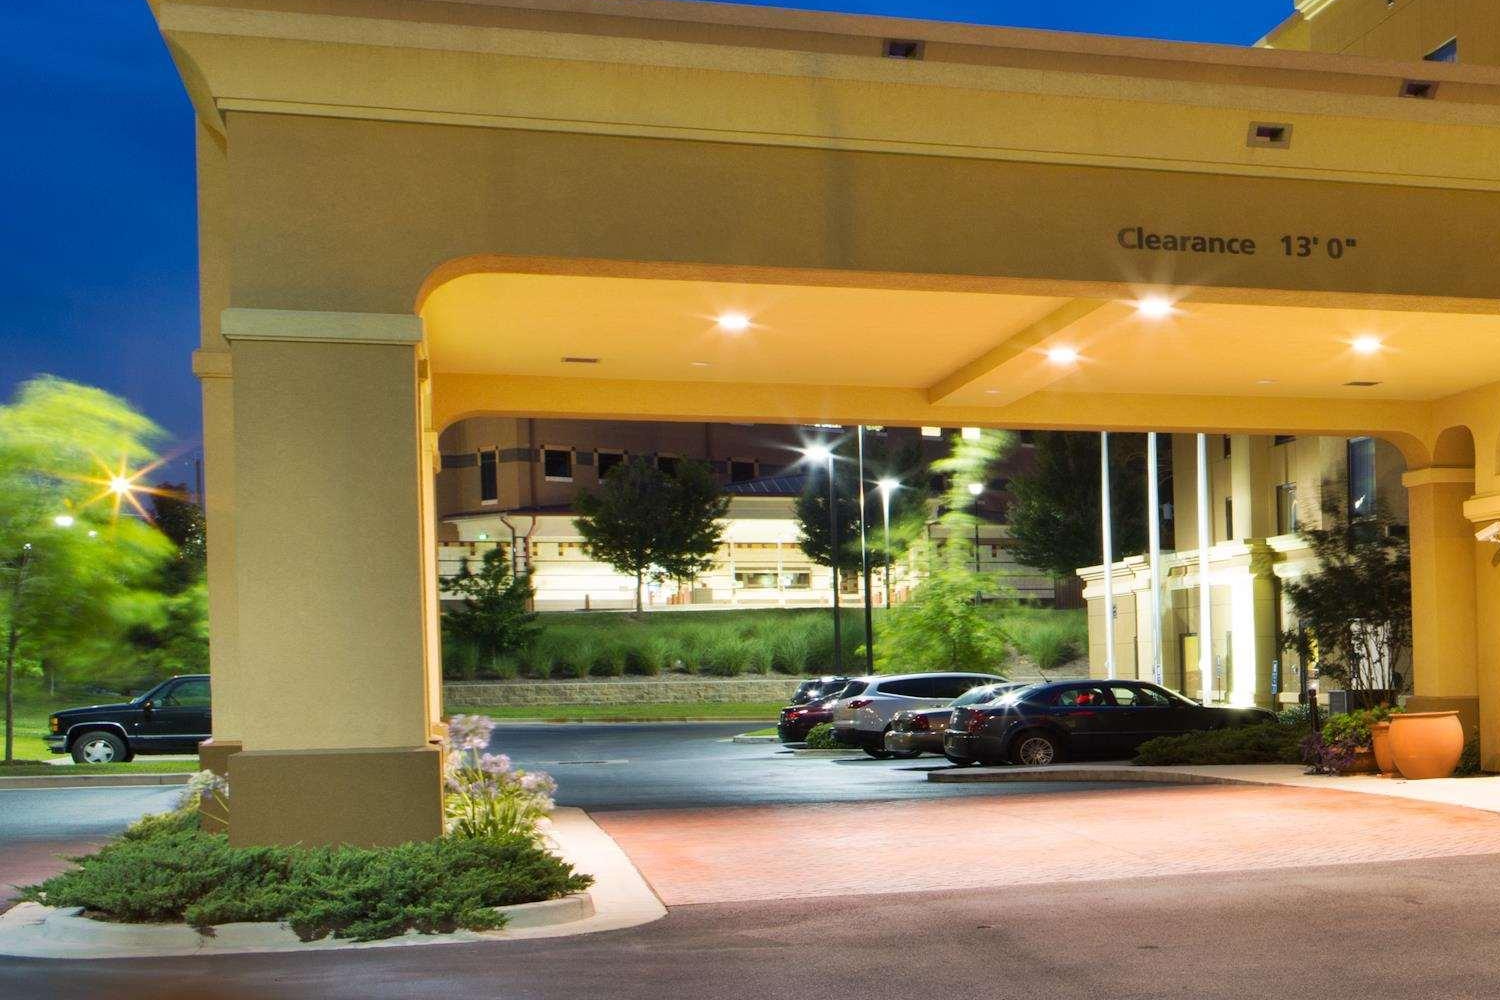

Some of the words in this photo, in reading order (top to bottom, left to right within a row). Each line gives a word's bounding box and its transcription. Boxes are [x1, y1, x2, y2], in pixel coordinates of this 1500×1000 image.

[1117, 226, 1256, 256] Clearance
[1280, 234, 1318, 258] 13'
[1326, 236, 1357, 260] 0"
